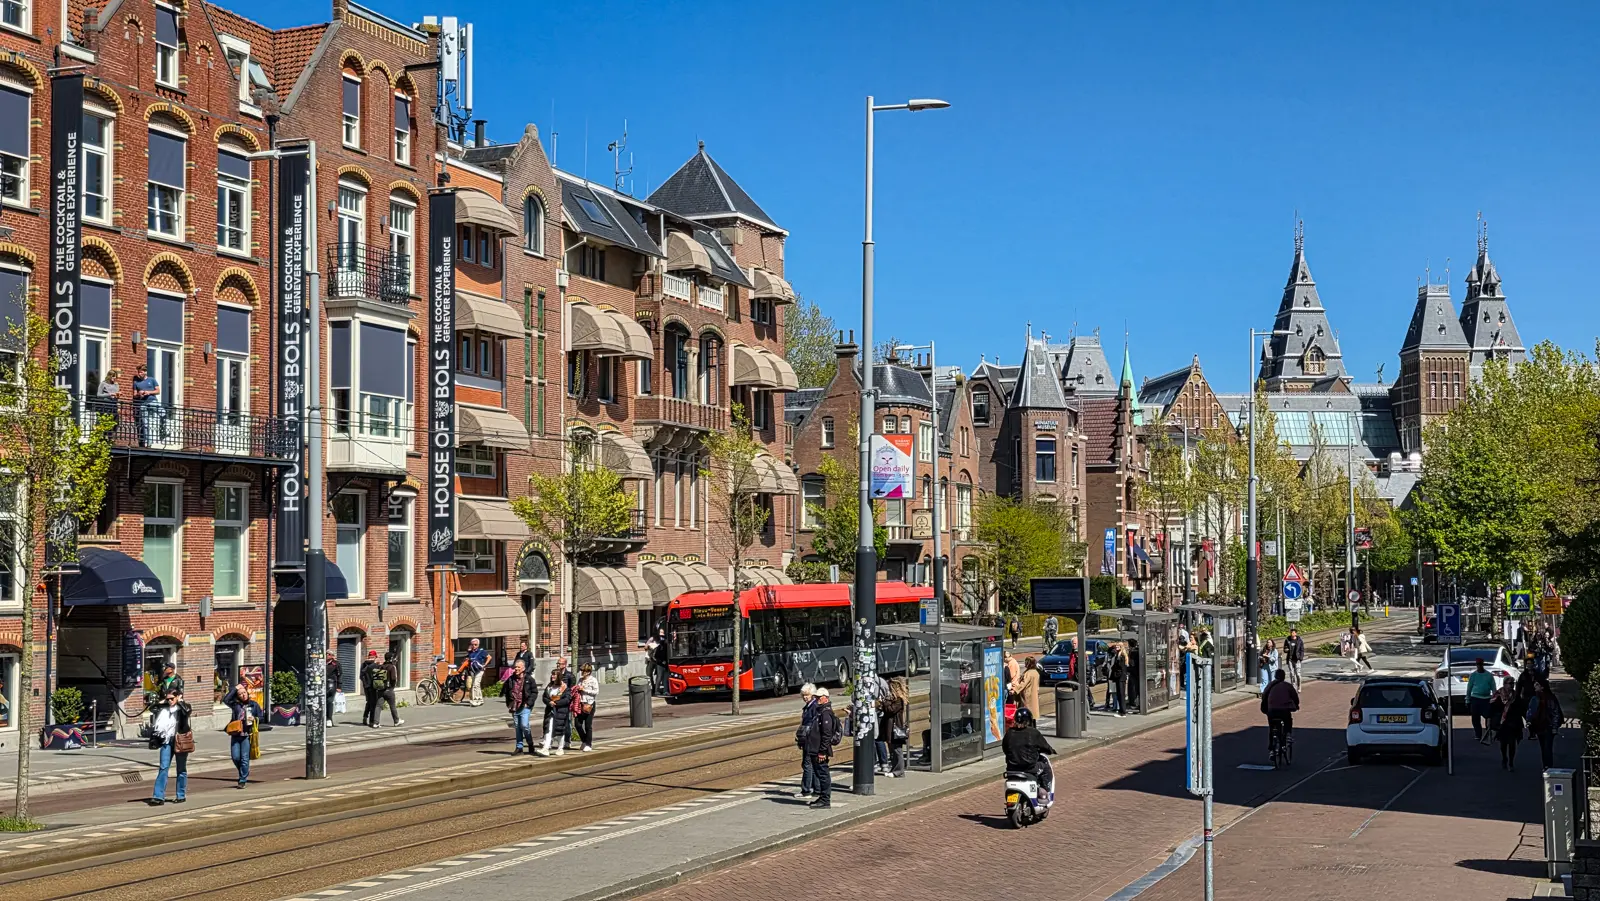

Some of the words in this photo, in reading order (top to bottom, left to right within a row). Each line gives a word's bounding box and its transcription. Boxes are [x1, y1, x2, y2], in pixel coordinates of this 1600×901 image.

[57, 169, 66, 180] &
[66, 132, 77, 209] EXPERIENCE
[56, 181, 66, 245] COCKTAIL
[285, 227, 294, 235] &
[294, 195, 302, 262] EXPERIENCE
[56, 248, 65, 273] THE
[66, 212, 75, 271] GENEVER
[285, 237, 293, 291] COCKTAIL
[443, 236, 451, 296] EXPERIENCE
[293, 263, 301, 314] GENEVER
[435, 265, 442, 273] &
[55, 280, 73, 345] BOLS
[285, 293, 293, 315] THE
[443, 297, 451, 343] GENEVER
[284, 321, 300, 377] BOLS
[435, 349, 450, 398] BOLS
[435, 421, 450, 448] OF
[434, 451, 450, 518] HOUSE
[873, 465, 891, 473] Open
[893, 465, 910, 473] daily
[1442, 605, 1455, 622] P
